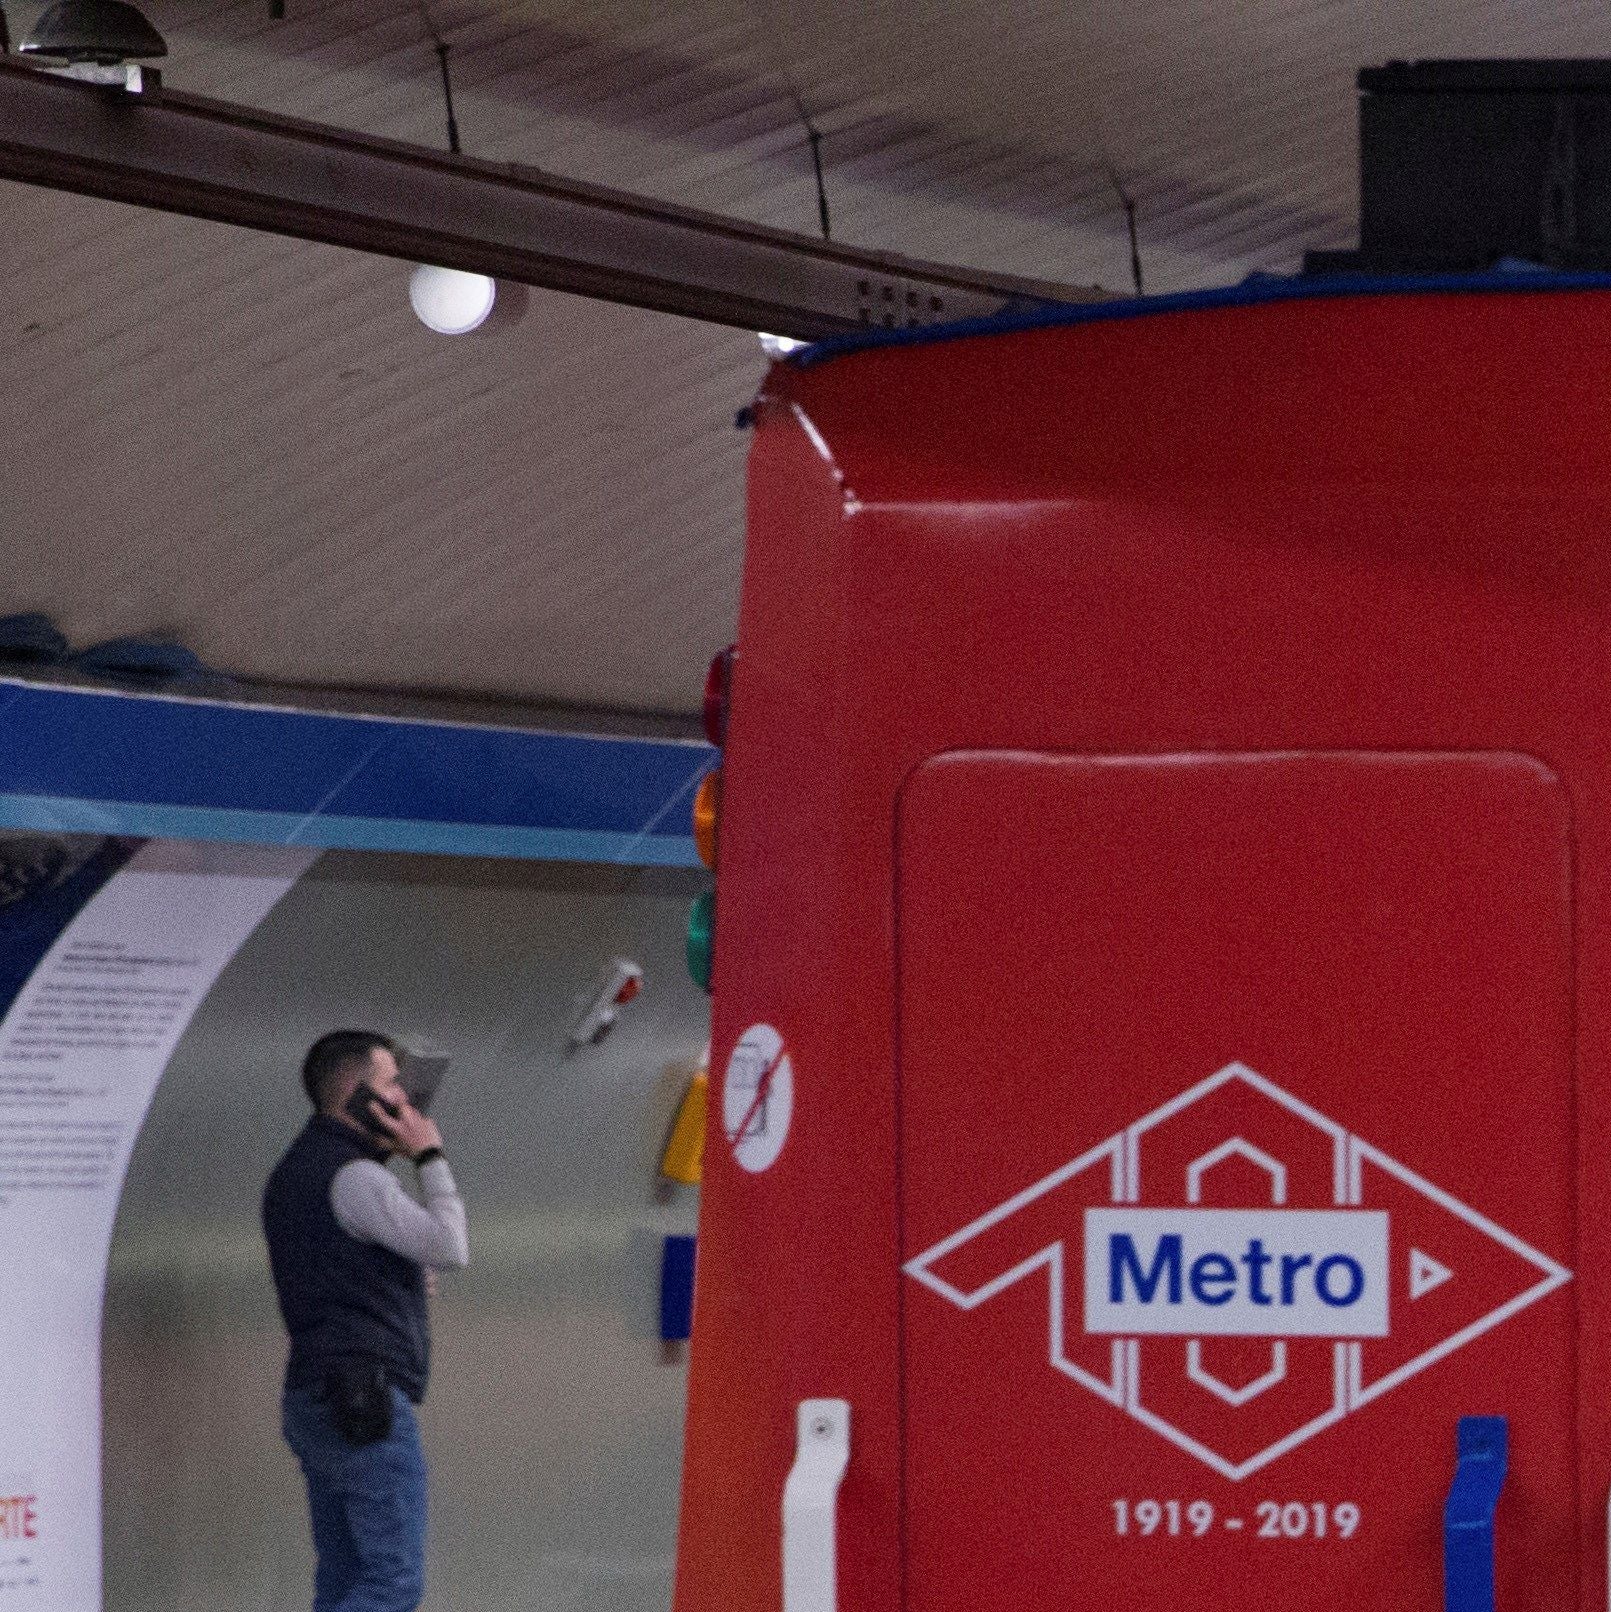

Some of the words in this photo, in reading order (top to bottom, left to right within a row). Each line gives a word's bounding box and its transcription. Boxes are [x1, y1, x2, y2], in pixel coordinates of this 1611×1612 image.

[1108, 1232, 1365, 1308] Metro
[1112, 1499, 1213, 1536] 1919
[1257, 1500, 1360, 1538] 2019
